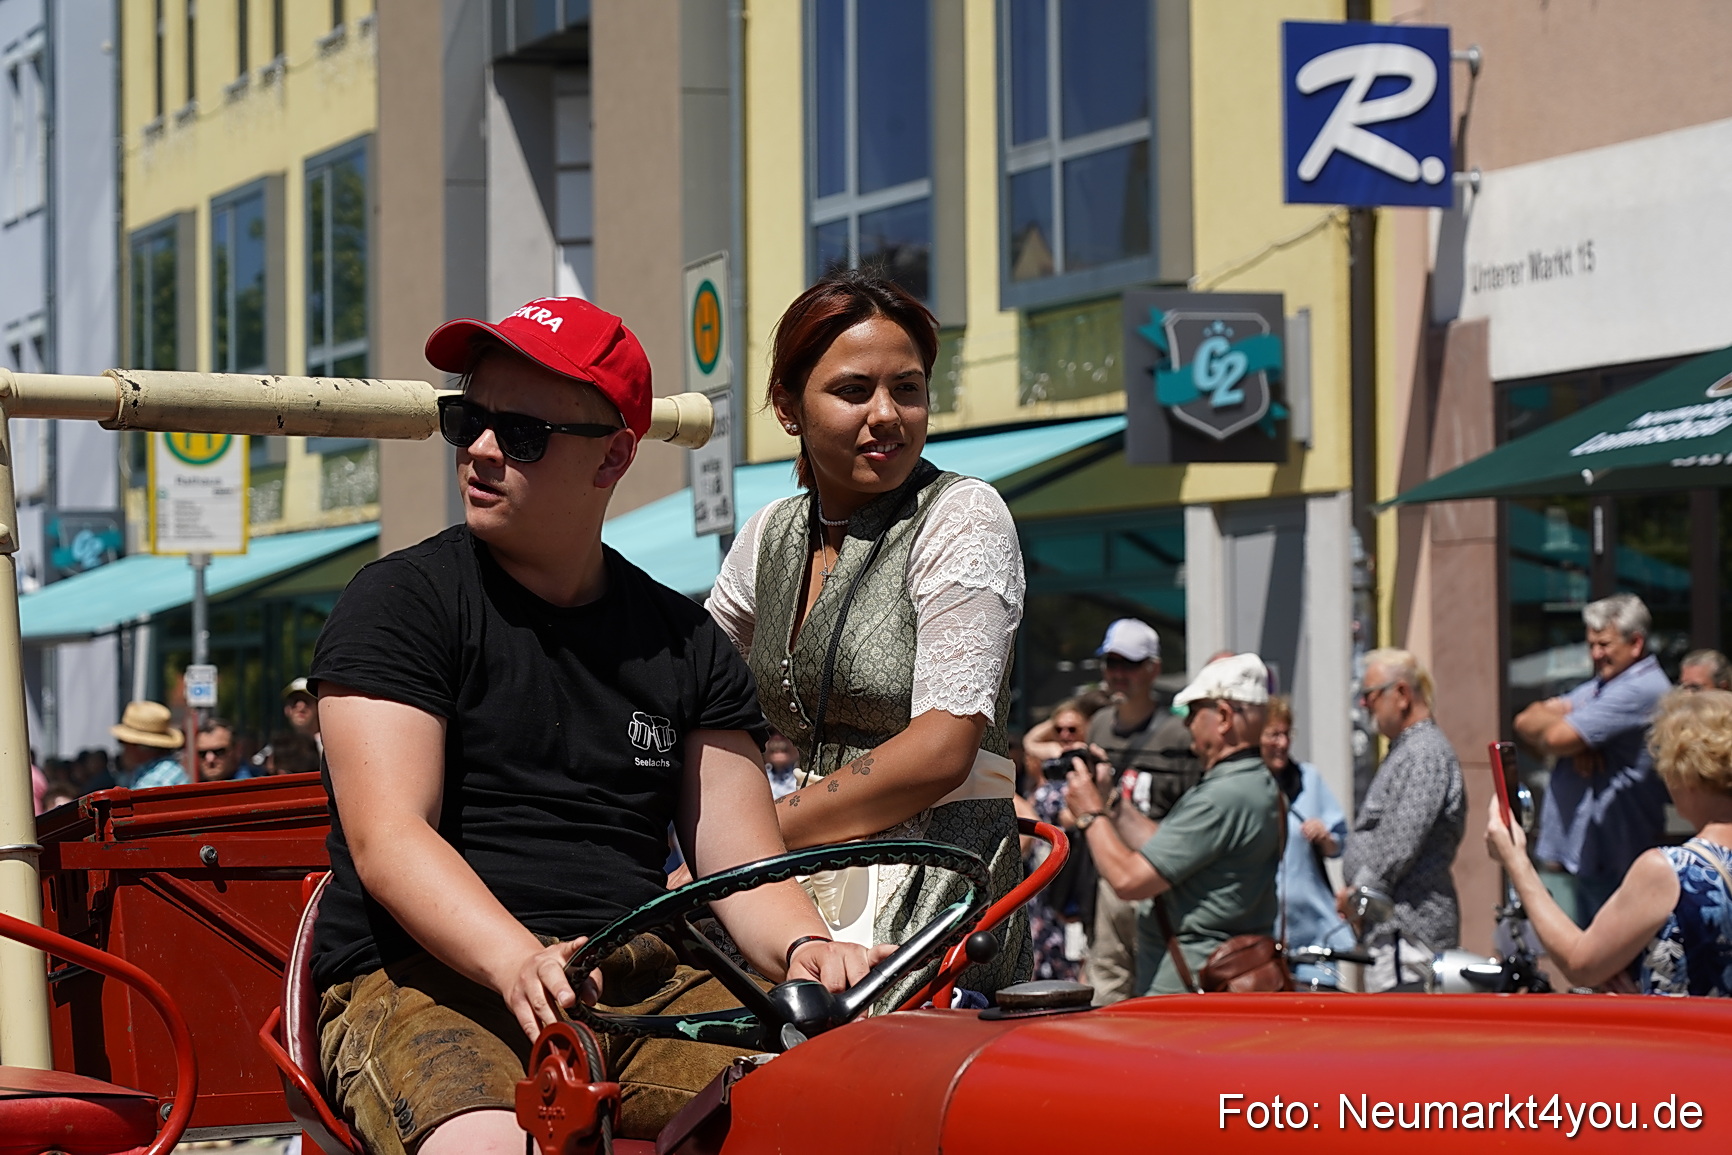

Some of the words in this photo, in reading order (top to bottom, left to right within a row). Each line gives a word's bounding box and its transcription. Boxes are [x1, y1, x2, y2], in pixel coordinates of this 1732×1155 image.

[1473, 262, 1524, 294] Unterer
[1528, 249, 1573, 282] Markt
[1576, 239, 1598, 274] 15
[1193, 336, 1249, 408] G2
[634, 757, 671, 768] Seelachs
